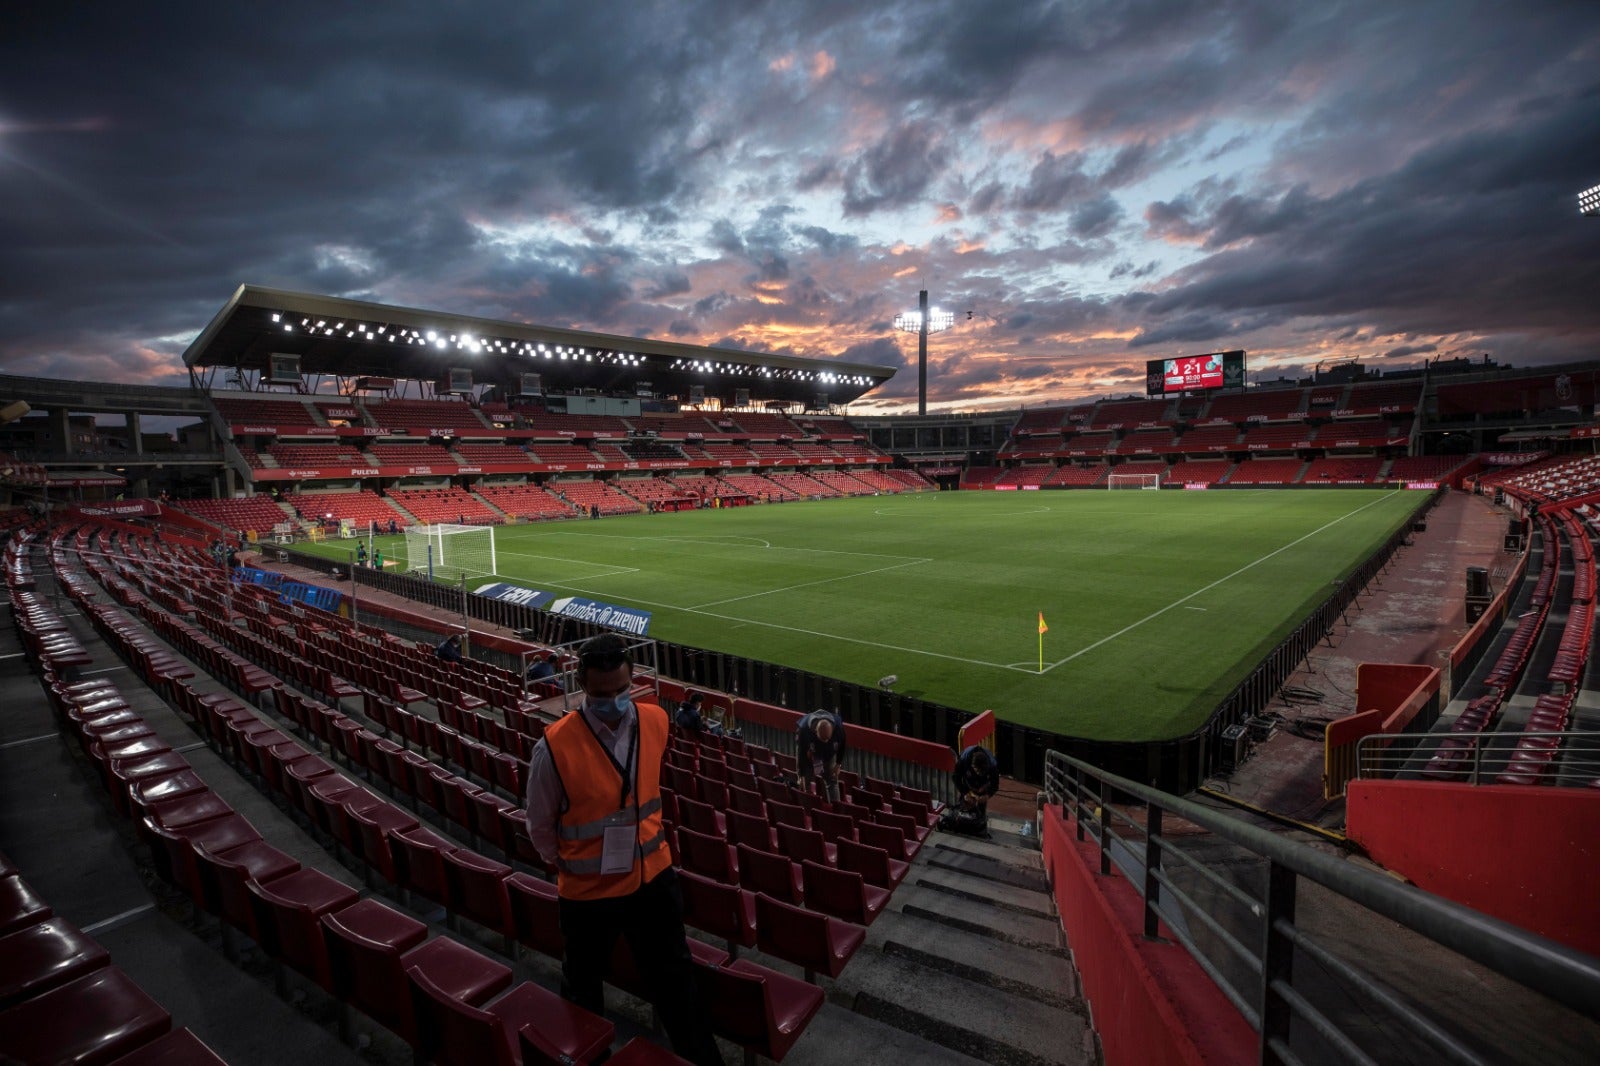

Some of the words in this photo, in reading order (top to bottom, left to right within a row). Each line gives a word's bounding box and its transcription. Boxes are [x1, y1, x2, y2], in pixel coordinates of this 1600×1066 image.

[328, 409, 356, 417] IDEAL
[363, 427, 391, 436] IDEAL
[561, 602, 602, 622] Seguros
[608, 610, 648, 635] Allianz
